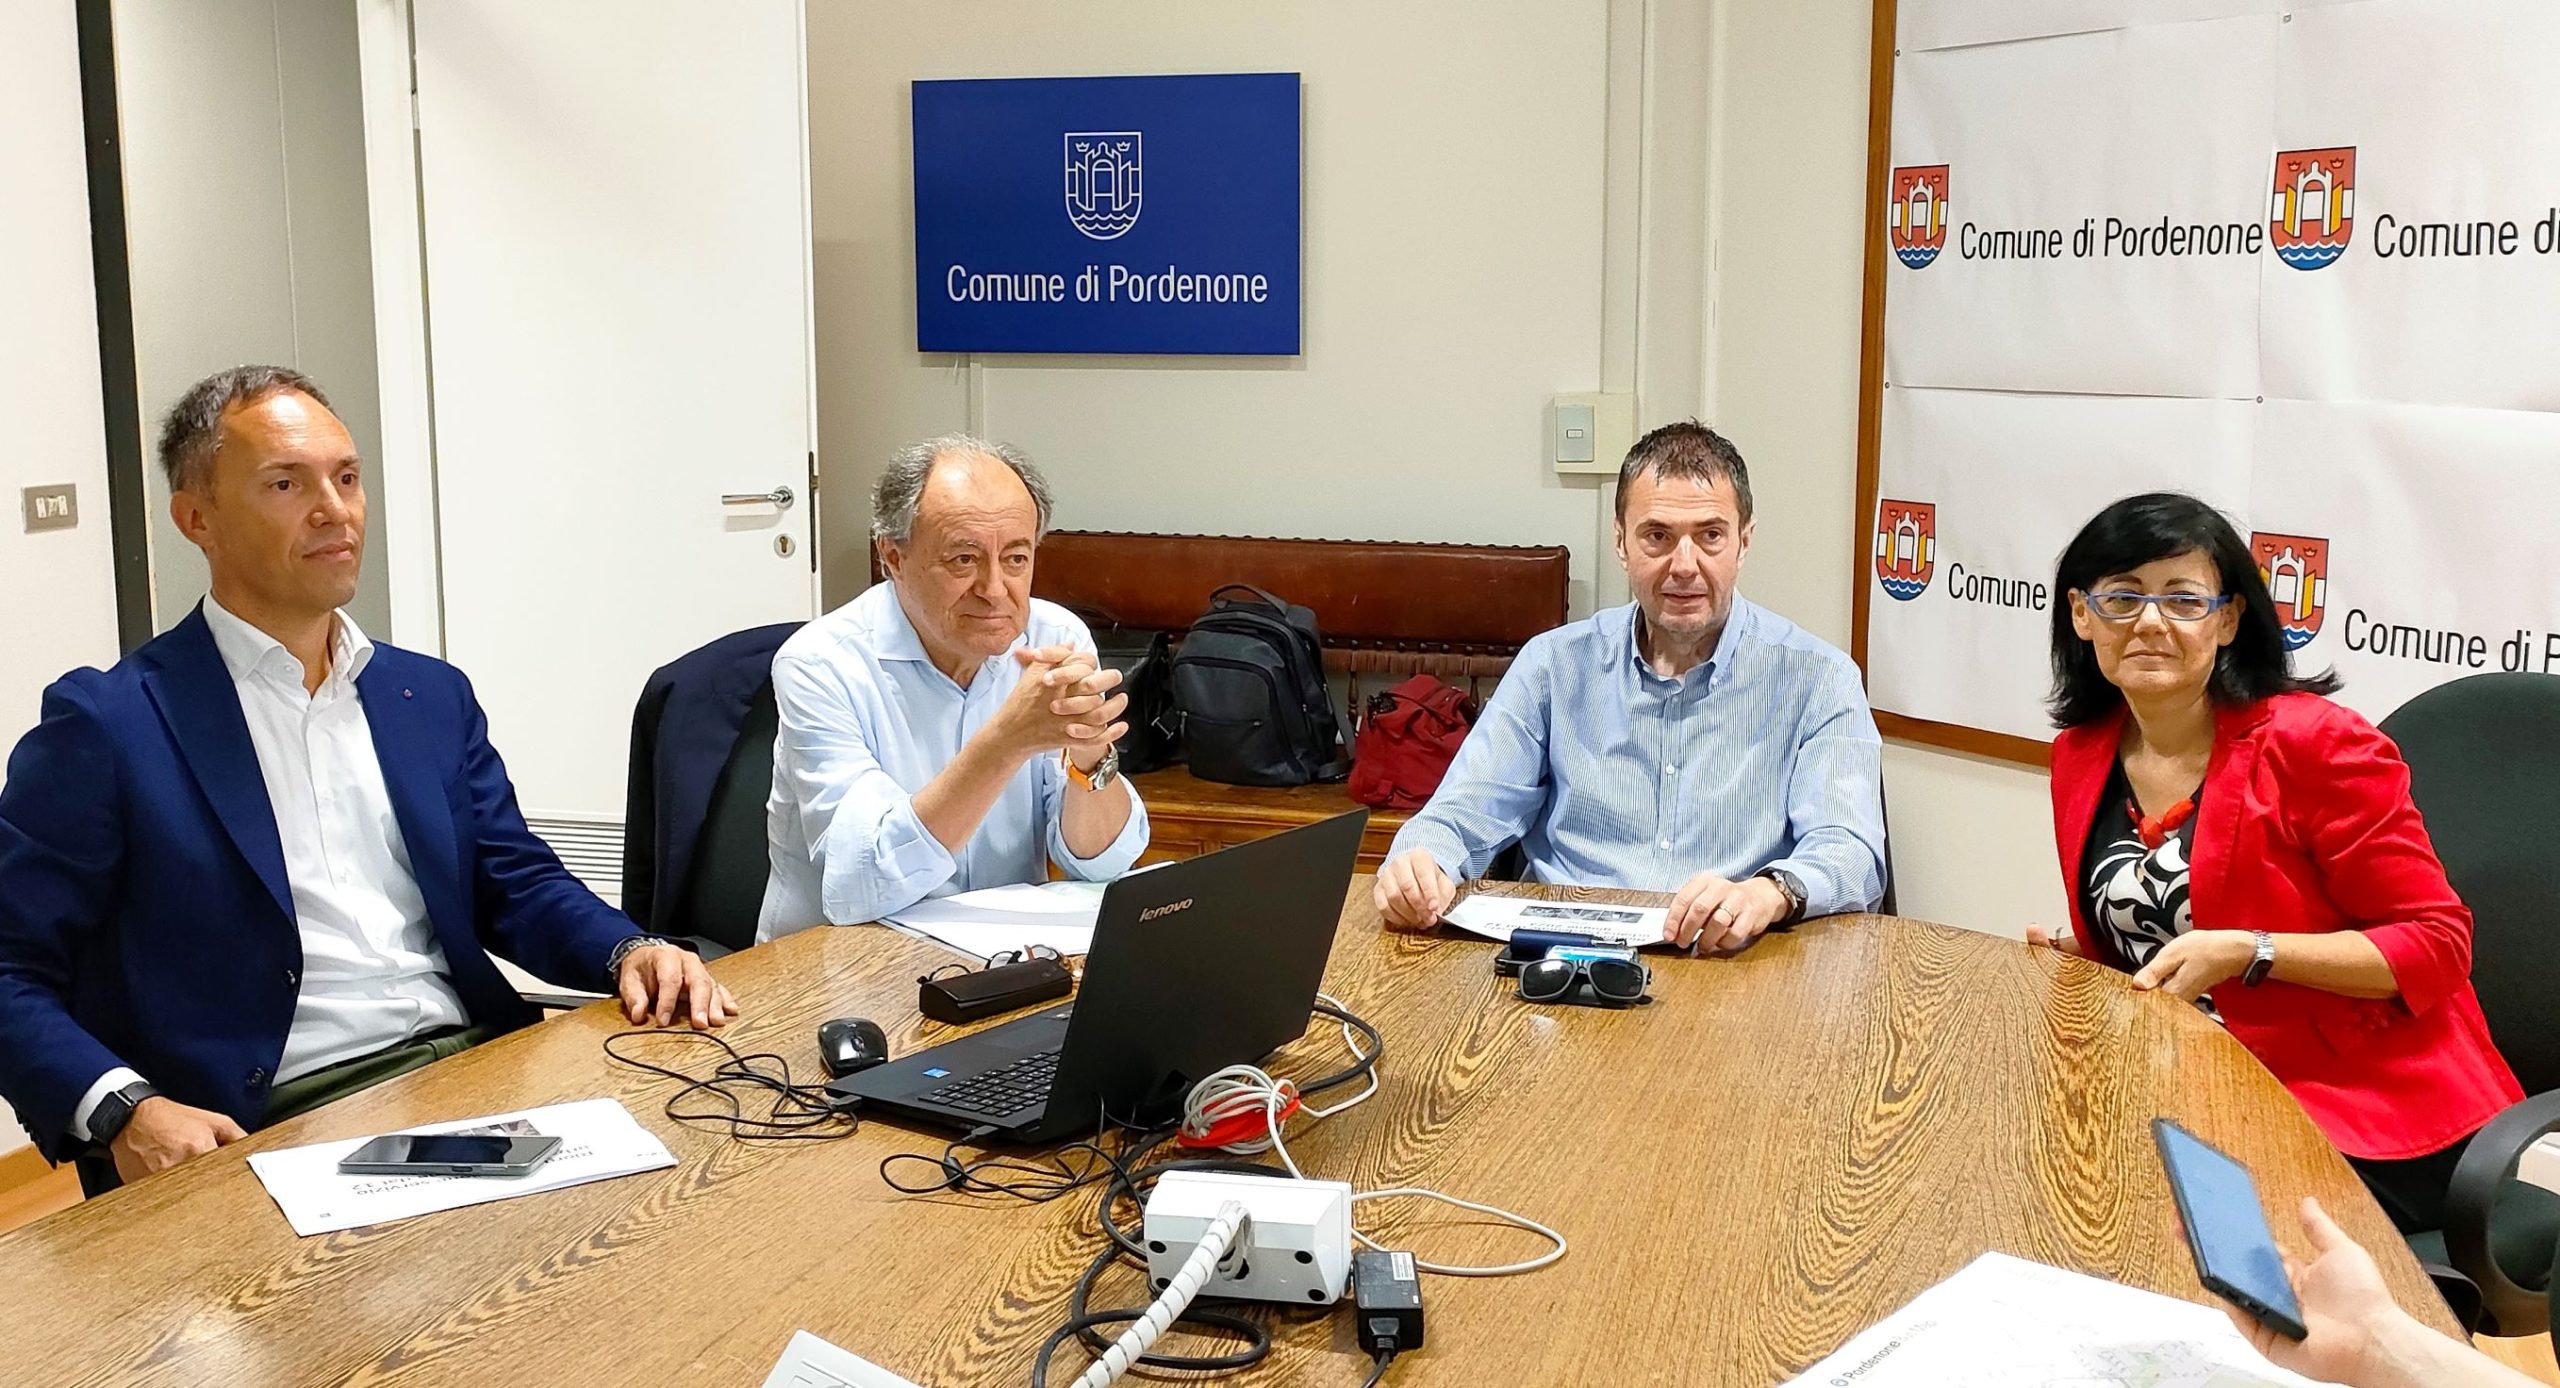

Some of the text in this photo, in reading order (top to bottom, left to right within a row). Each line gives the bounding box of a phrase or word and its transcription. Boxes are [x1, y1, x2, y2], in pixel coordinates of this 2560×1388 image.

[1960, 216, 2264, 260] Comune di Pordenone
[2374, 212, 2519, 259] Comune
[947, 264, 1268, 303] Comune di Pordenone
[1948, 562, 2048, 611] Comune
[2345, 608, 2487, 668] Comune
[2501, 629, 2531, 673] di
[1139, 898, 1193, 923] lenovo
